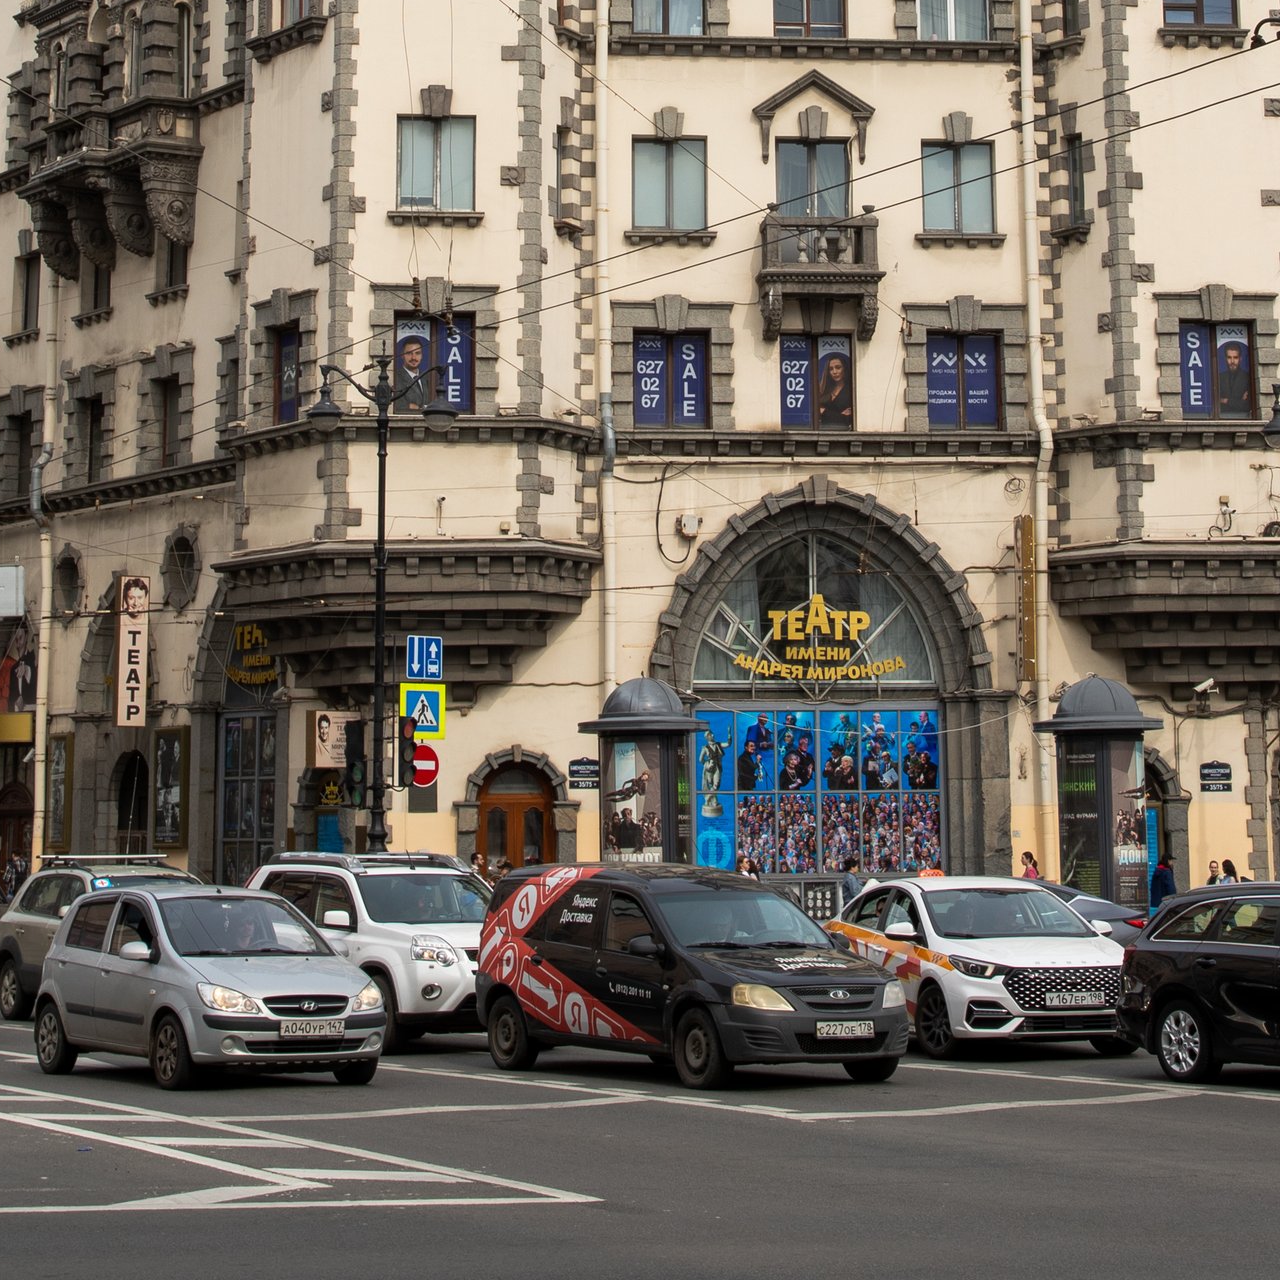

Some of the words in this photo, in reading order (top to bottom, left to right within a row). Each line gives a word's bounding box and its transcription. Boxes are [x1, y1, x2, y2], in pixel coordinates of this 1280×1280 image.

[447, 331, 462, 403] SALE
[636, 360, 664, 375] 627
[782, 360, 809, 375] 627
[1186, 331, 1204, 406] SALE
[641, 377, 660, 391] 02
[681, 344, 698, 417] SALE
[786, 377, 805, 392] 02
[641, 394, 660, 408] 67
[786, 394, 805, 408] 67
[768, 593, 870, 641] ТЕАТР
[786, 646, 850, 661] ИМЕНИ
[733, 652, 804, 679] АНДРЕЯ
[806, 655, 907, 681] МИРОНОВА
[126, 630, 141, 721] ТЕАТР
[572, 894, 598, 907] Яндекс
[560, 909, 593, 923] Доставка
[628, 984, 638, 996] 201
[638, 986, 645, 997] 11
[646, 987, 652, 999] 11
[283, 1022, 325, 1034] А040УР
[326, 1021, 343, 1032] 147
